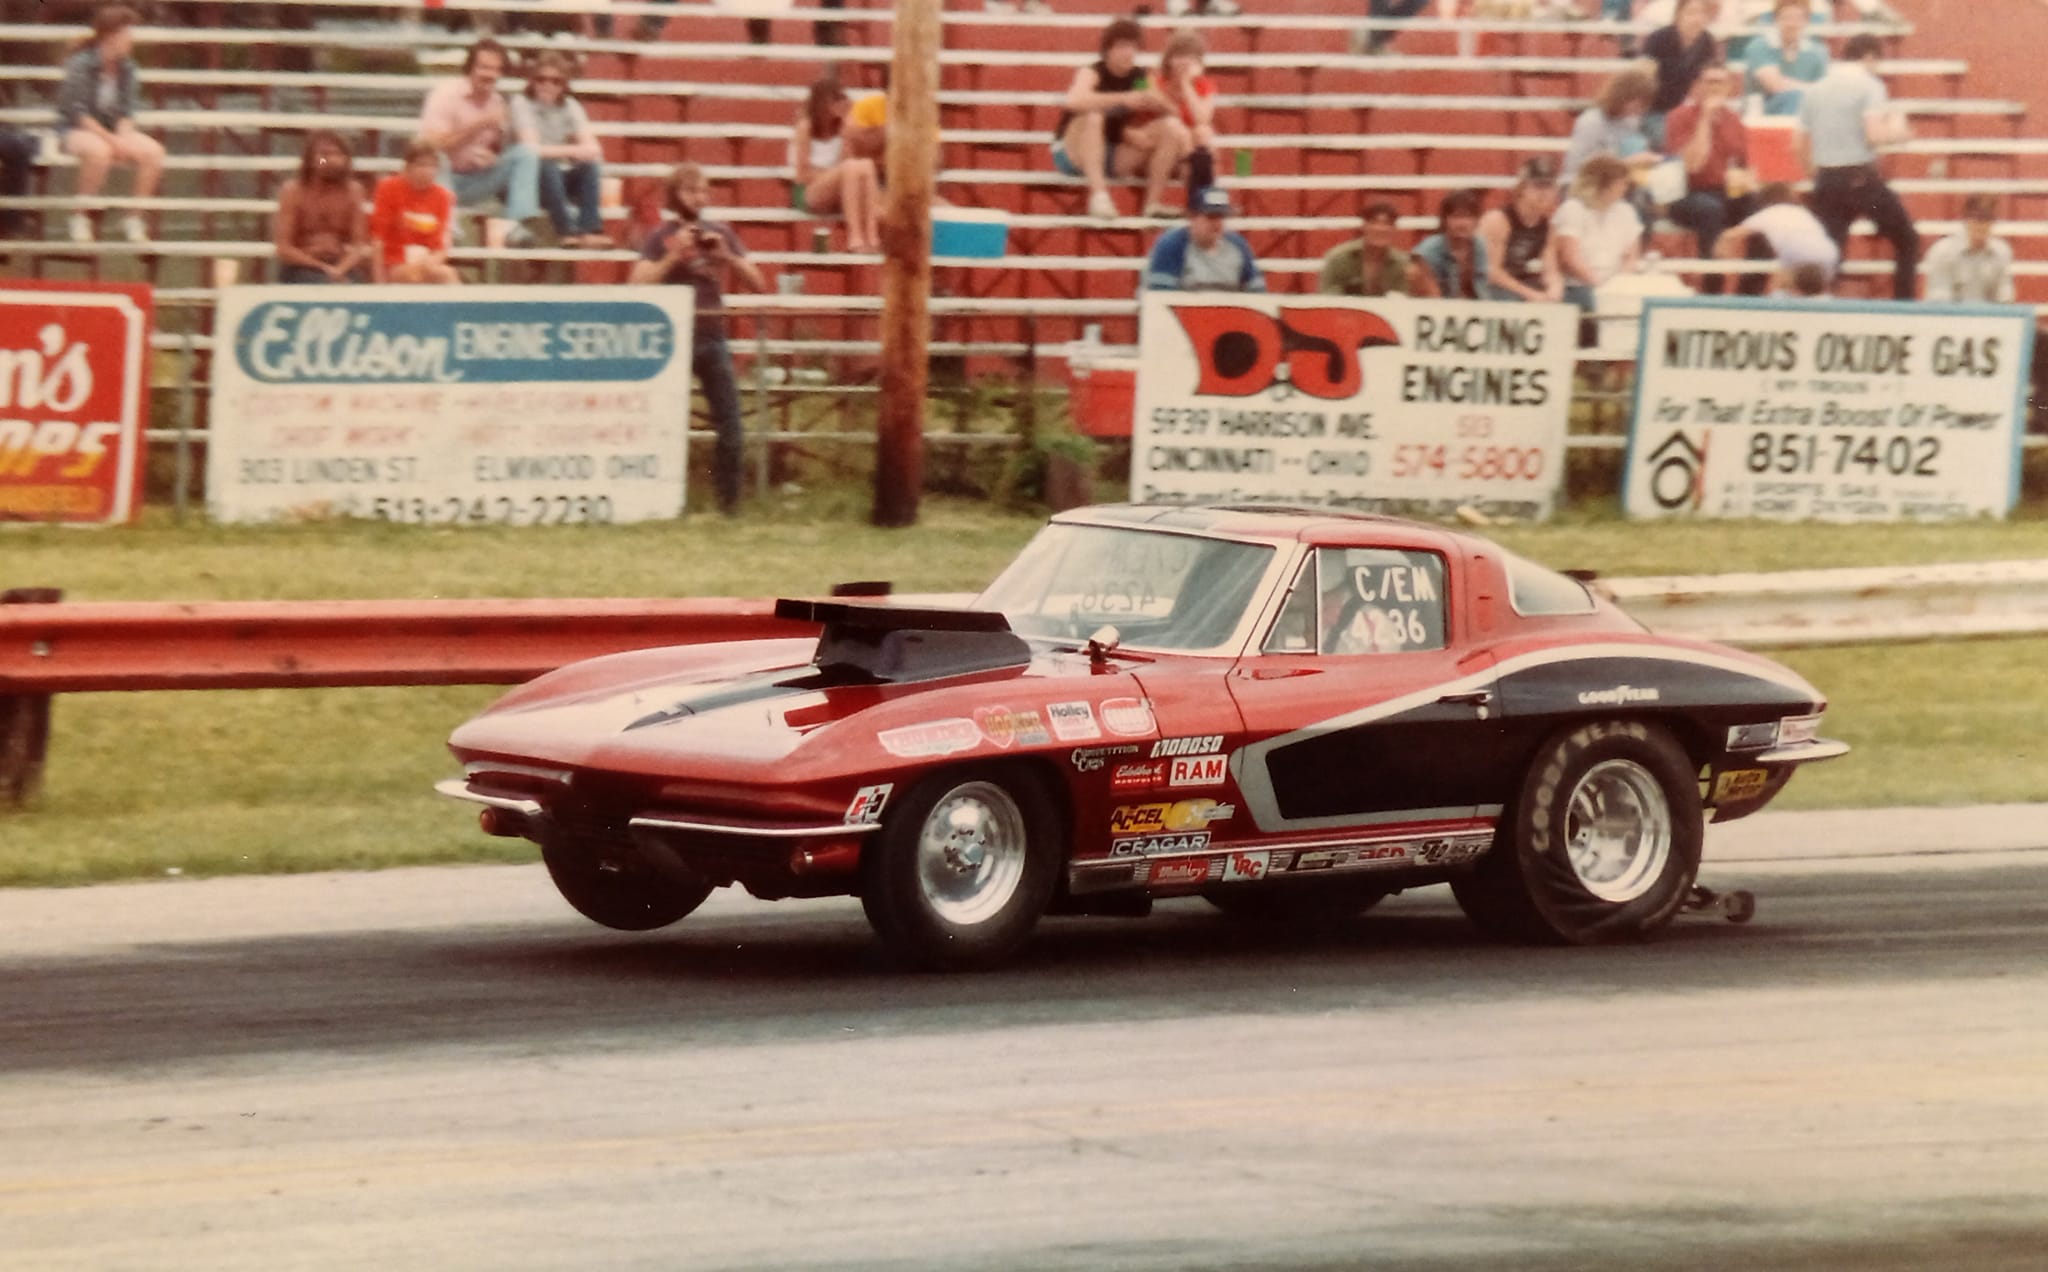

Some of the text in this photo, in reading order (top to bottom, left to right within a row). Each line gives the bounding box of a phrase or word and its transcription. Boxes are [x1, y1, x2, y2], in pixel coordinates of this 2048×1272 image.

[249, 305, 667, 381] Ellison ENGINE SERVICE
[1415, 315, 1544, 355] RACING
[1663, 329, 2001, 377] NITROUS OXIDE GAS
[1403, 365, 1549, 406] ENGINES
[1150, 408, 1209, 435] 5939
[1216, 409, 1327, 438] HARRISON
[1694, 397, 1746, 425] That
[1751, 398, 1815, 427] Extra
[1819, 400, 1892, 428] Boost
[475, 455, 594, 483] ELMWOOD
[1147, 446, 1275, 473] CINCINNATI
[1308, 449, 1370, 477] OHIO
[1746, 432, 1941, 477] 851-7402
[239, 458, 282, 485] 303
[292, 458, 378, 484] LINDEN
[1051, 703, 1089, 719] Holley
[1150, 735, 1225, 759] MOROSO
[1174, 759, 1223, 781] RAM
[1111, 807, 1164, 830] ACCEL
[1115, 835, 1207, 855] CRAGAR
